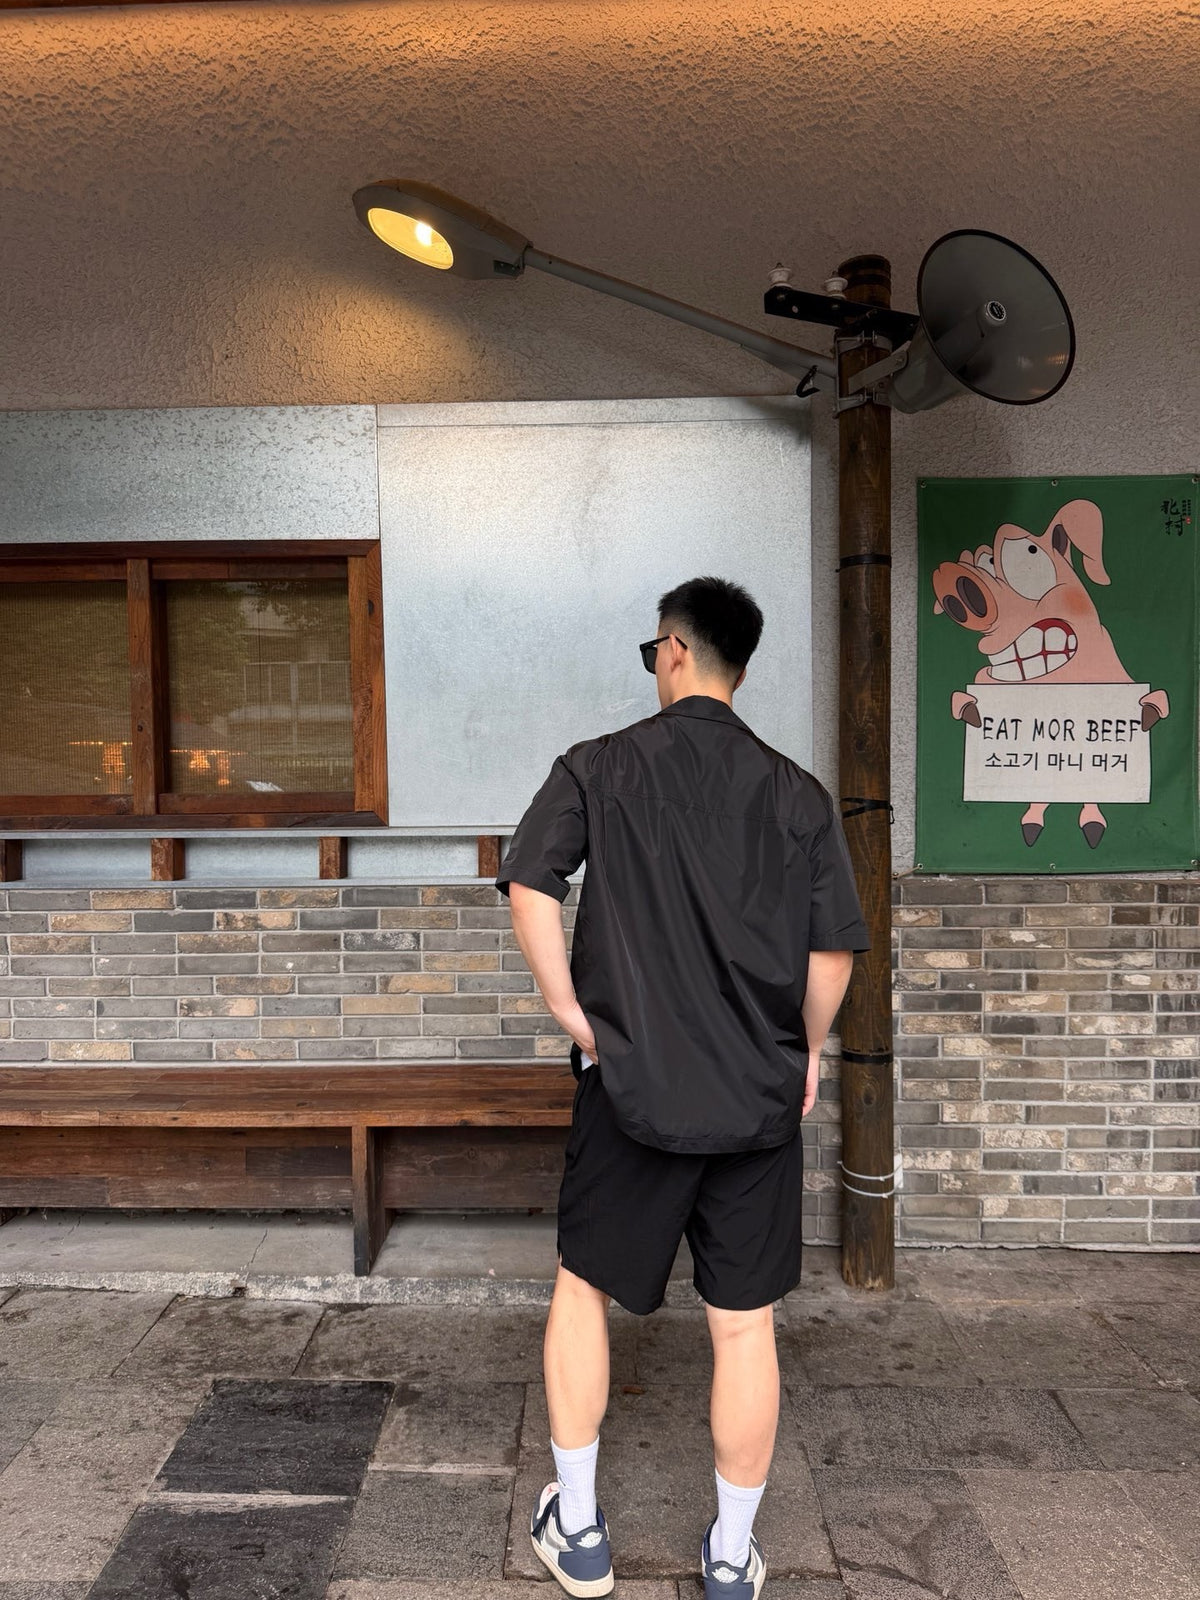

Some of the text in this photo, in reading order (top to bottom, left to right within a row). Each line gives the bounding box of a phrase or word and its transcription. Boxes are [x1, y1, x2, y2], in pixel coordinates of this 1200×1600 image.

[983, 717, 1141, 742] EAT MOR BEEF
[985, 752, 1128, 772] 소고기 마니 머거
